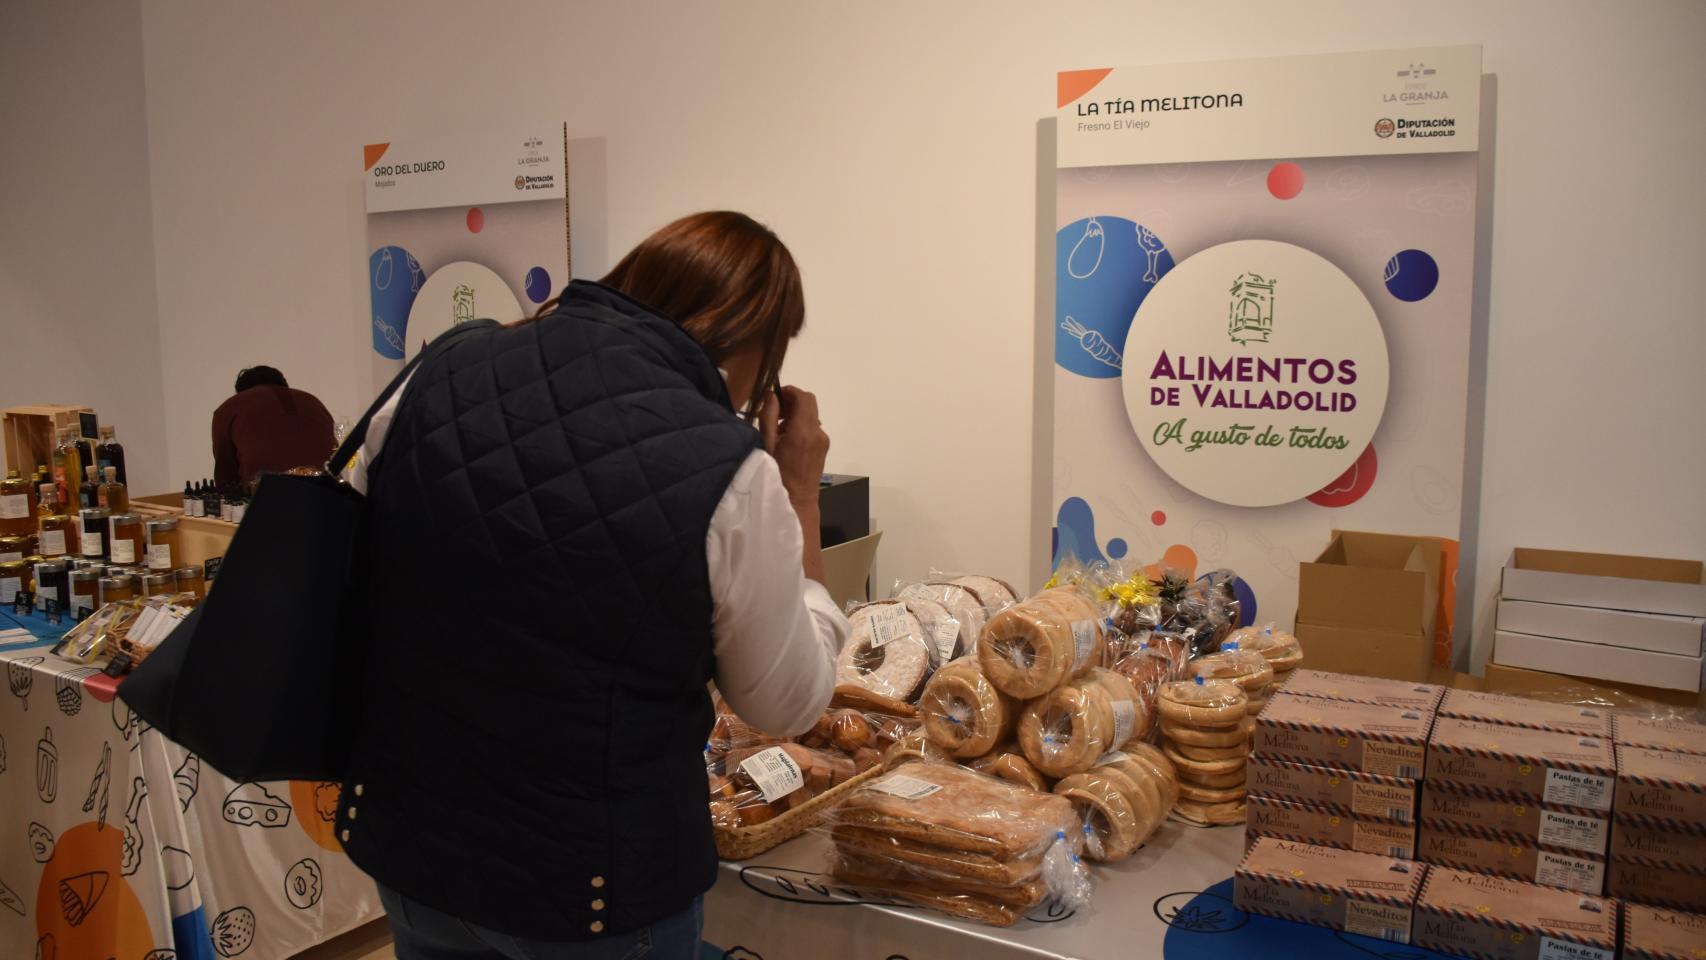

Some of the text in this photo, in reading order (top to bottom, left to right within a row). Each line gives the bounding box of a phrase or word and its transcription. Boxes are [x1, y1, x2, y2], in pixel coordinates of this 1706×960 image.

[1383, 90, 1448, 102] LA GRANJA
[1078, 93, 1243, 117] LA TÍA MELITONA
[1077, 119, 1150, 132] Fresno El Viejo
[374, 160, 446, 177] ORO DEL DUERO
[1149, 350, 1358, 385] ALIMENTOS
[1150, 383, 1357, 412] DE VALLADOLID
[1153, 418, 1350, 453] A gusto de todos
[1366, 742, 1422, 759] Nevaditos
[1553, 772, 1581, 783] Pastas
[1583, 777, 1594, 786] de
[1356, 784, 1411, 801] Nevaditos
[1577, 819, 1588, 827] de
[1357, 823, 1412, 841] Nevaditos
[1575, 861, 1585, 869] de
[1351, 902, 1409, 923] Nevaditos
[1580, 948, 1592, 958] de
